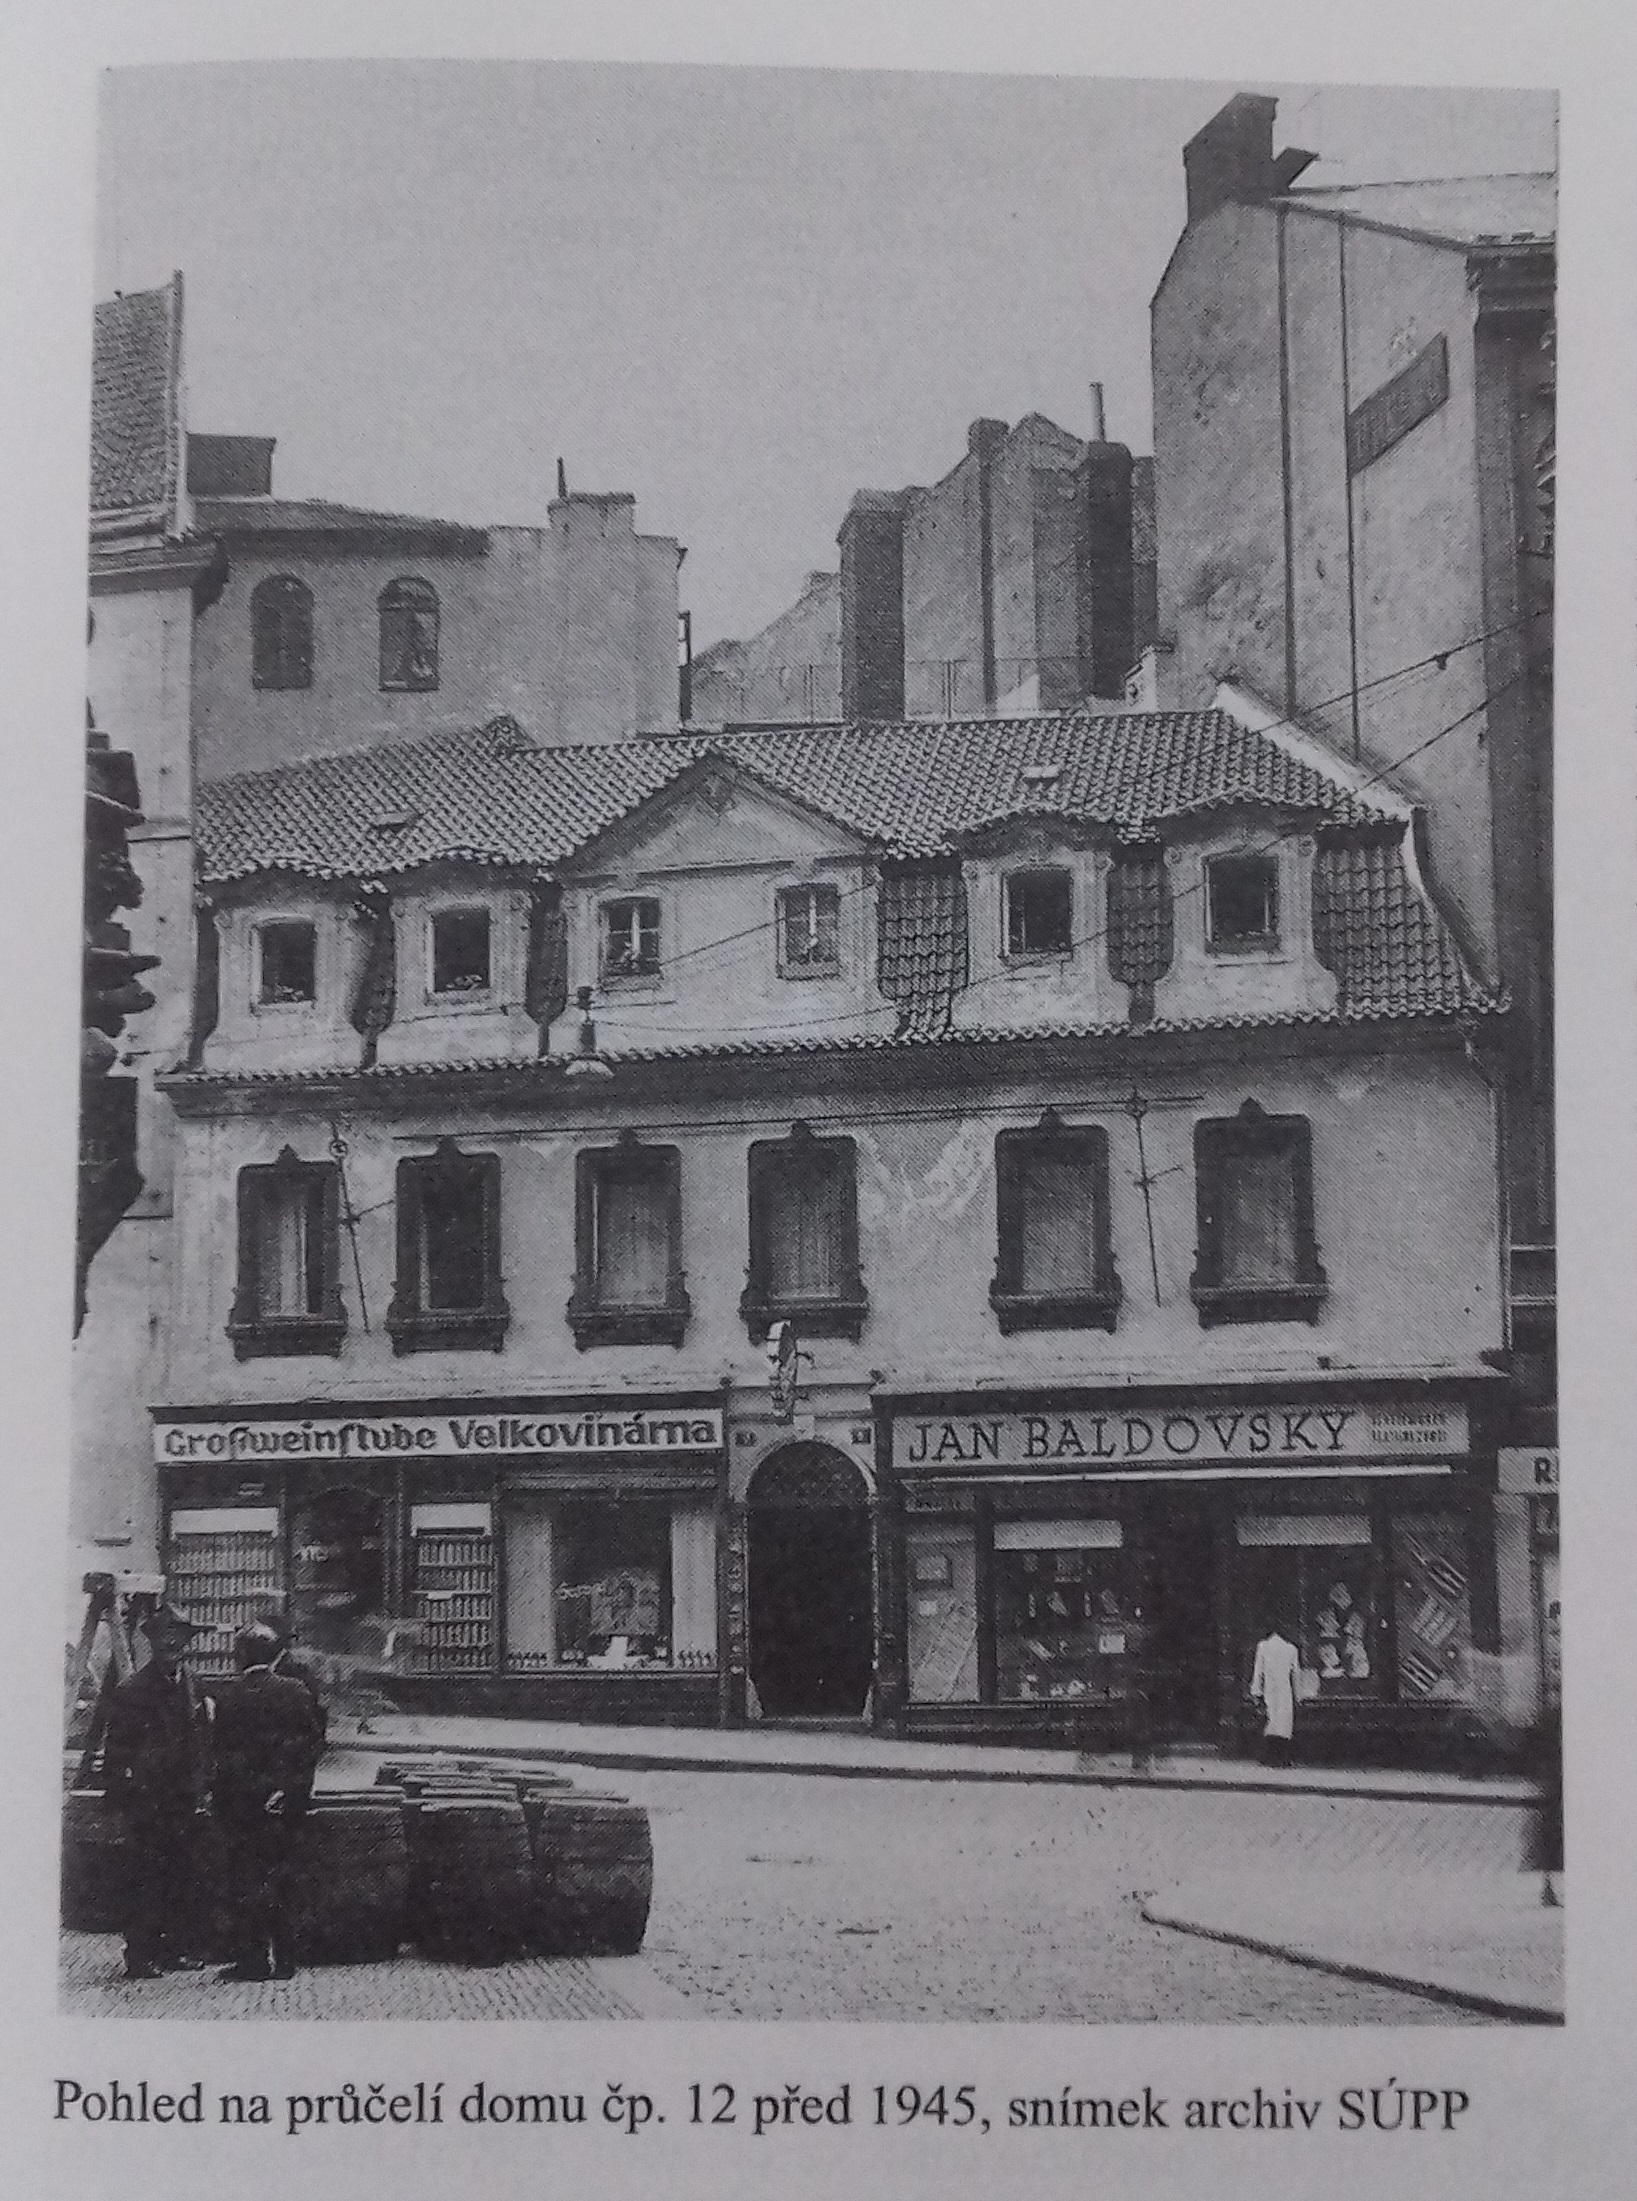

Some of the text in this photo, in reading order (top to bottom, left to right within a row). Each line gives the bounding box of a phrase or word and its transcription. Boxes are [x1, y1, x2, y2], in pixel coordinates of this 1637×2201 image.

[448, 1411, 718, 1450] Velkovinárna
[908, 1408, 1355, 1463] JAN BALDOVSKY
[53, 2076, 1470, 2136] Pohled na průčelí domu čp. 12 před 1945, snímek archiv SÚPP
